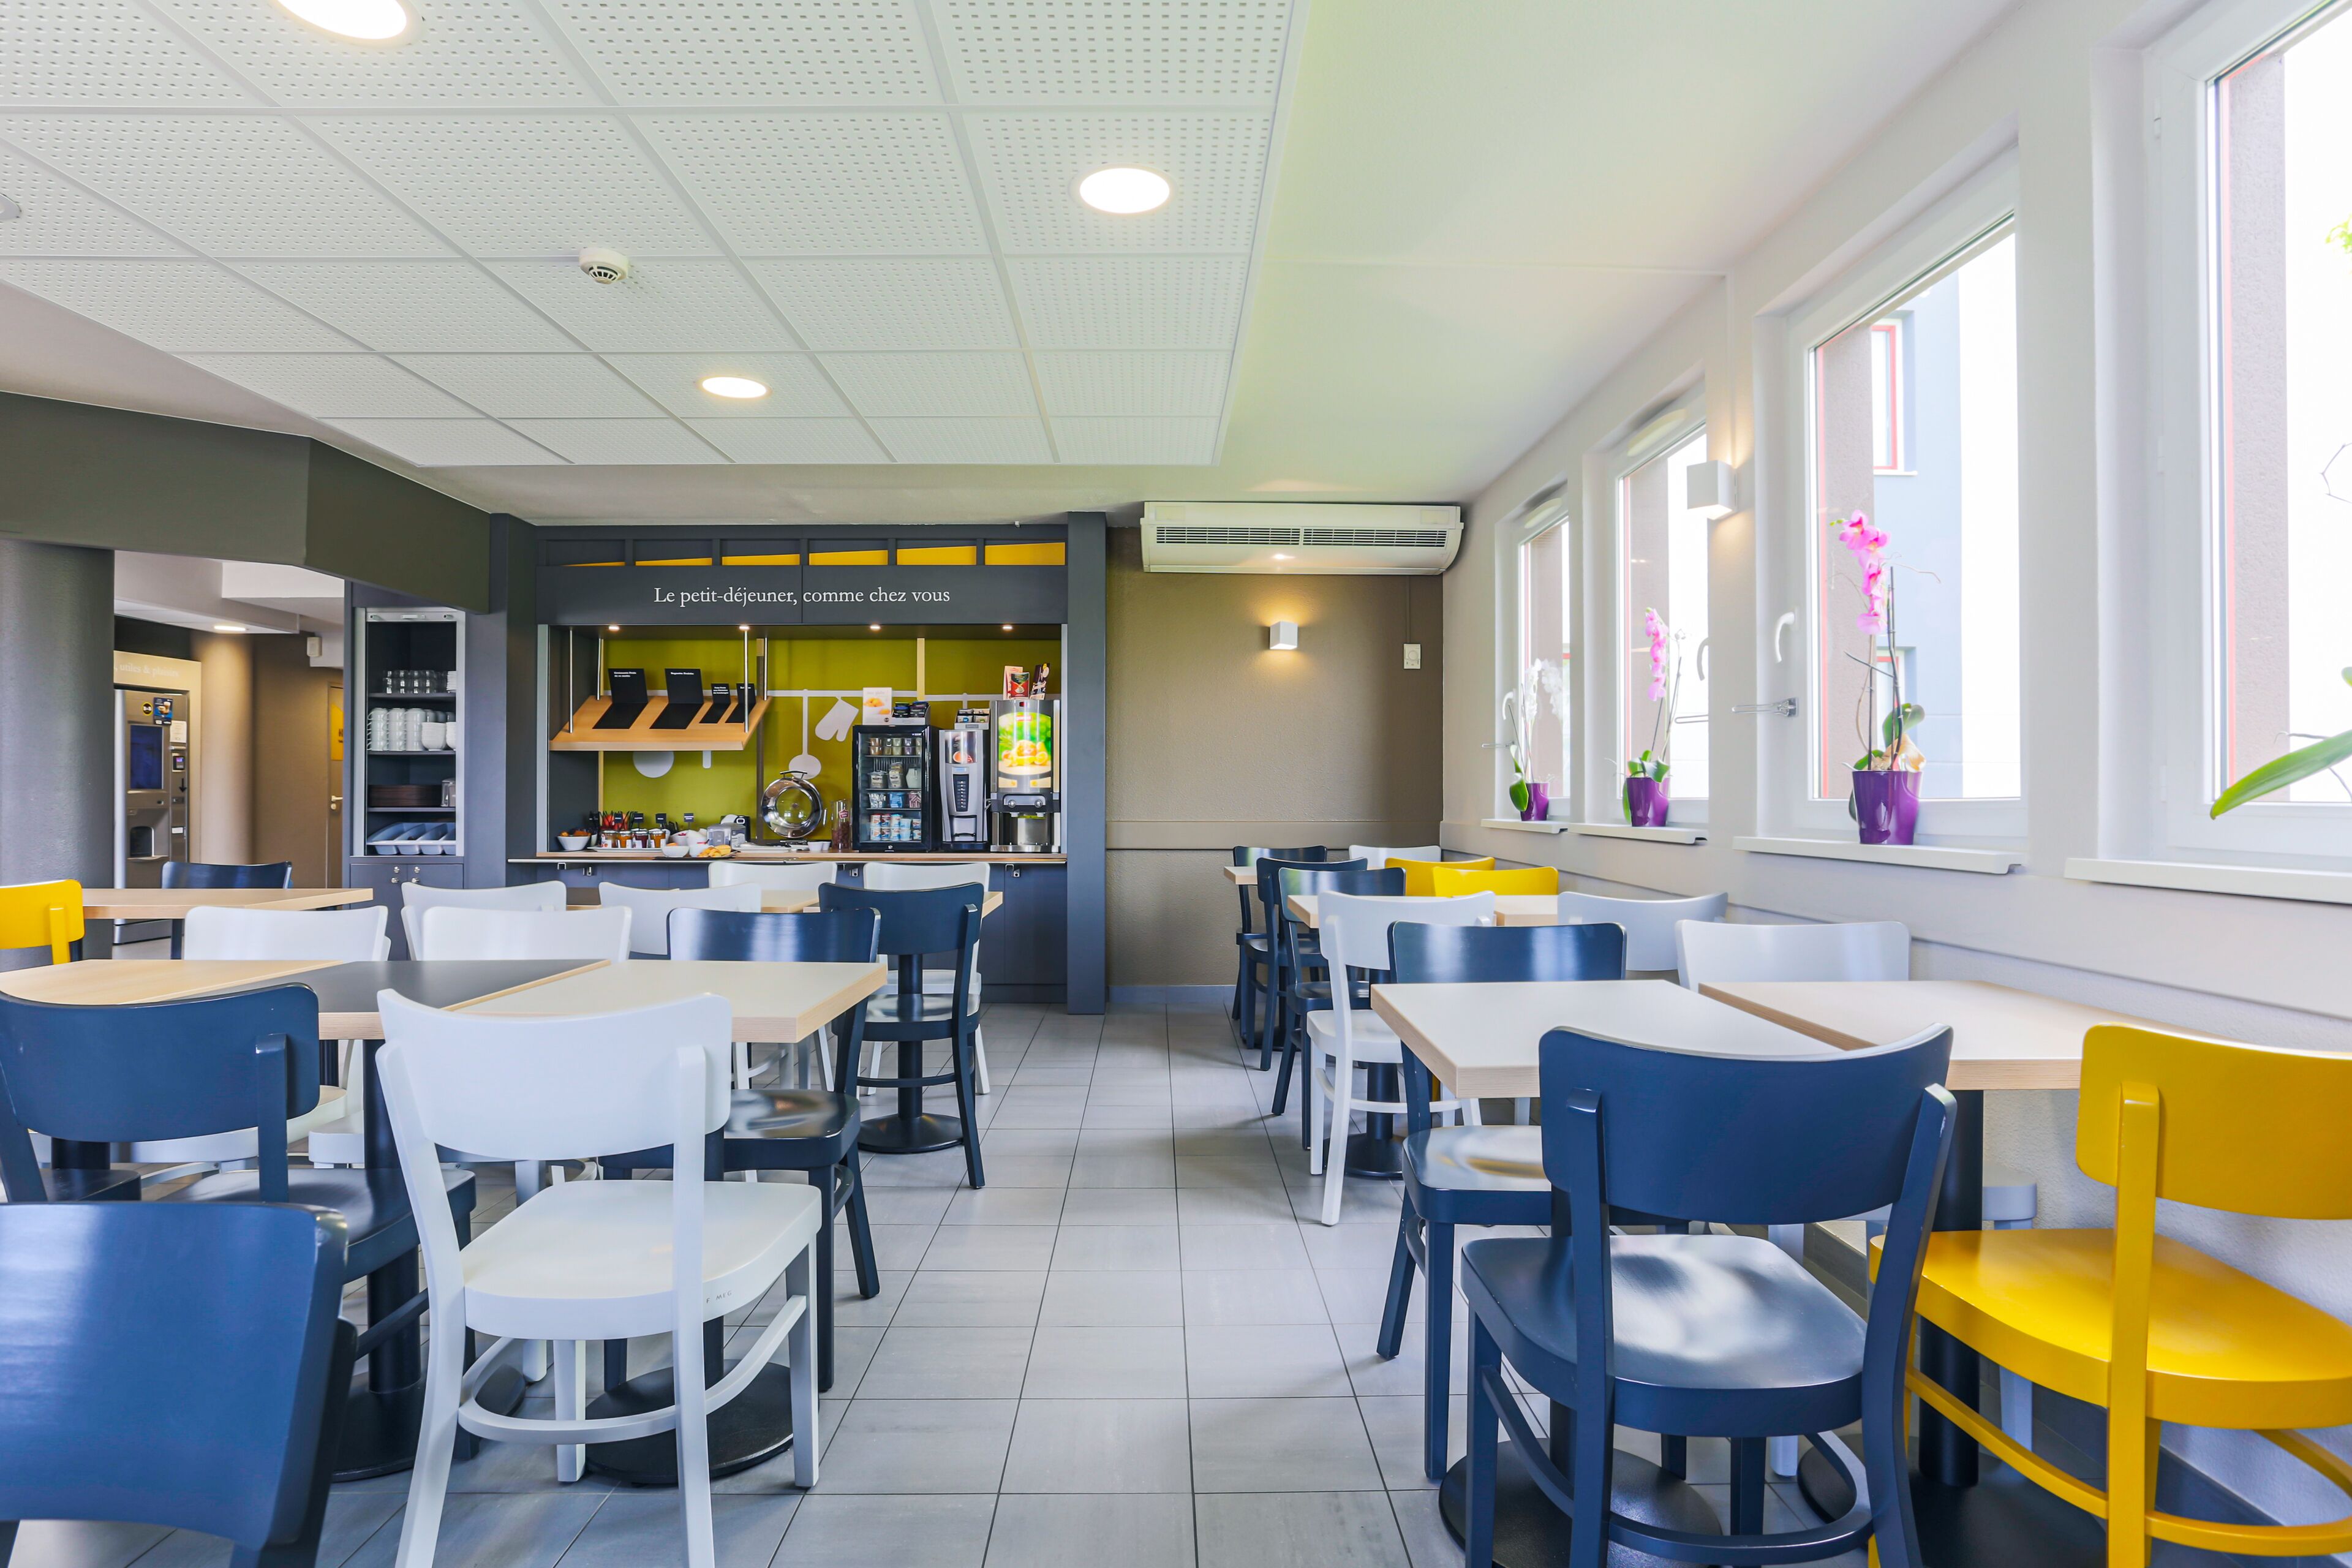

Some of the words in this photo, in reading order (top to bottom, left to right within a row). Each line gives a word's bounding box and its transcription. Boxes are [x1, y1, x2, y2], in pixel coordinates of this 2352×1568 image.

[654, 587, 675, 603] Le
[680, 587, 797, 608] petit-déjeuner,
[803, 591, 864, 603] comme
[869, 586, 907, 603] chez
[911, 590, 950, 603] vous
